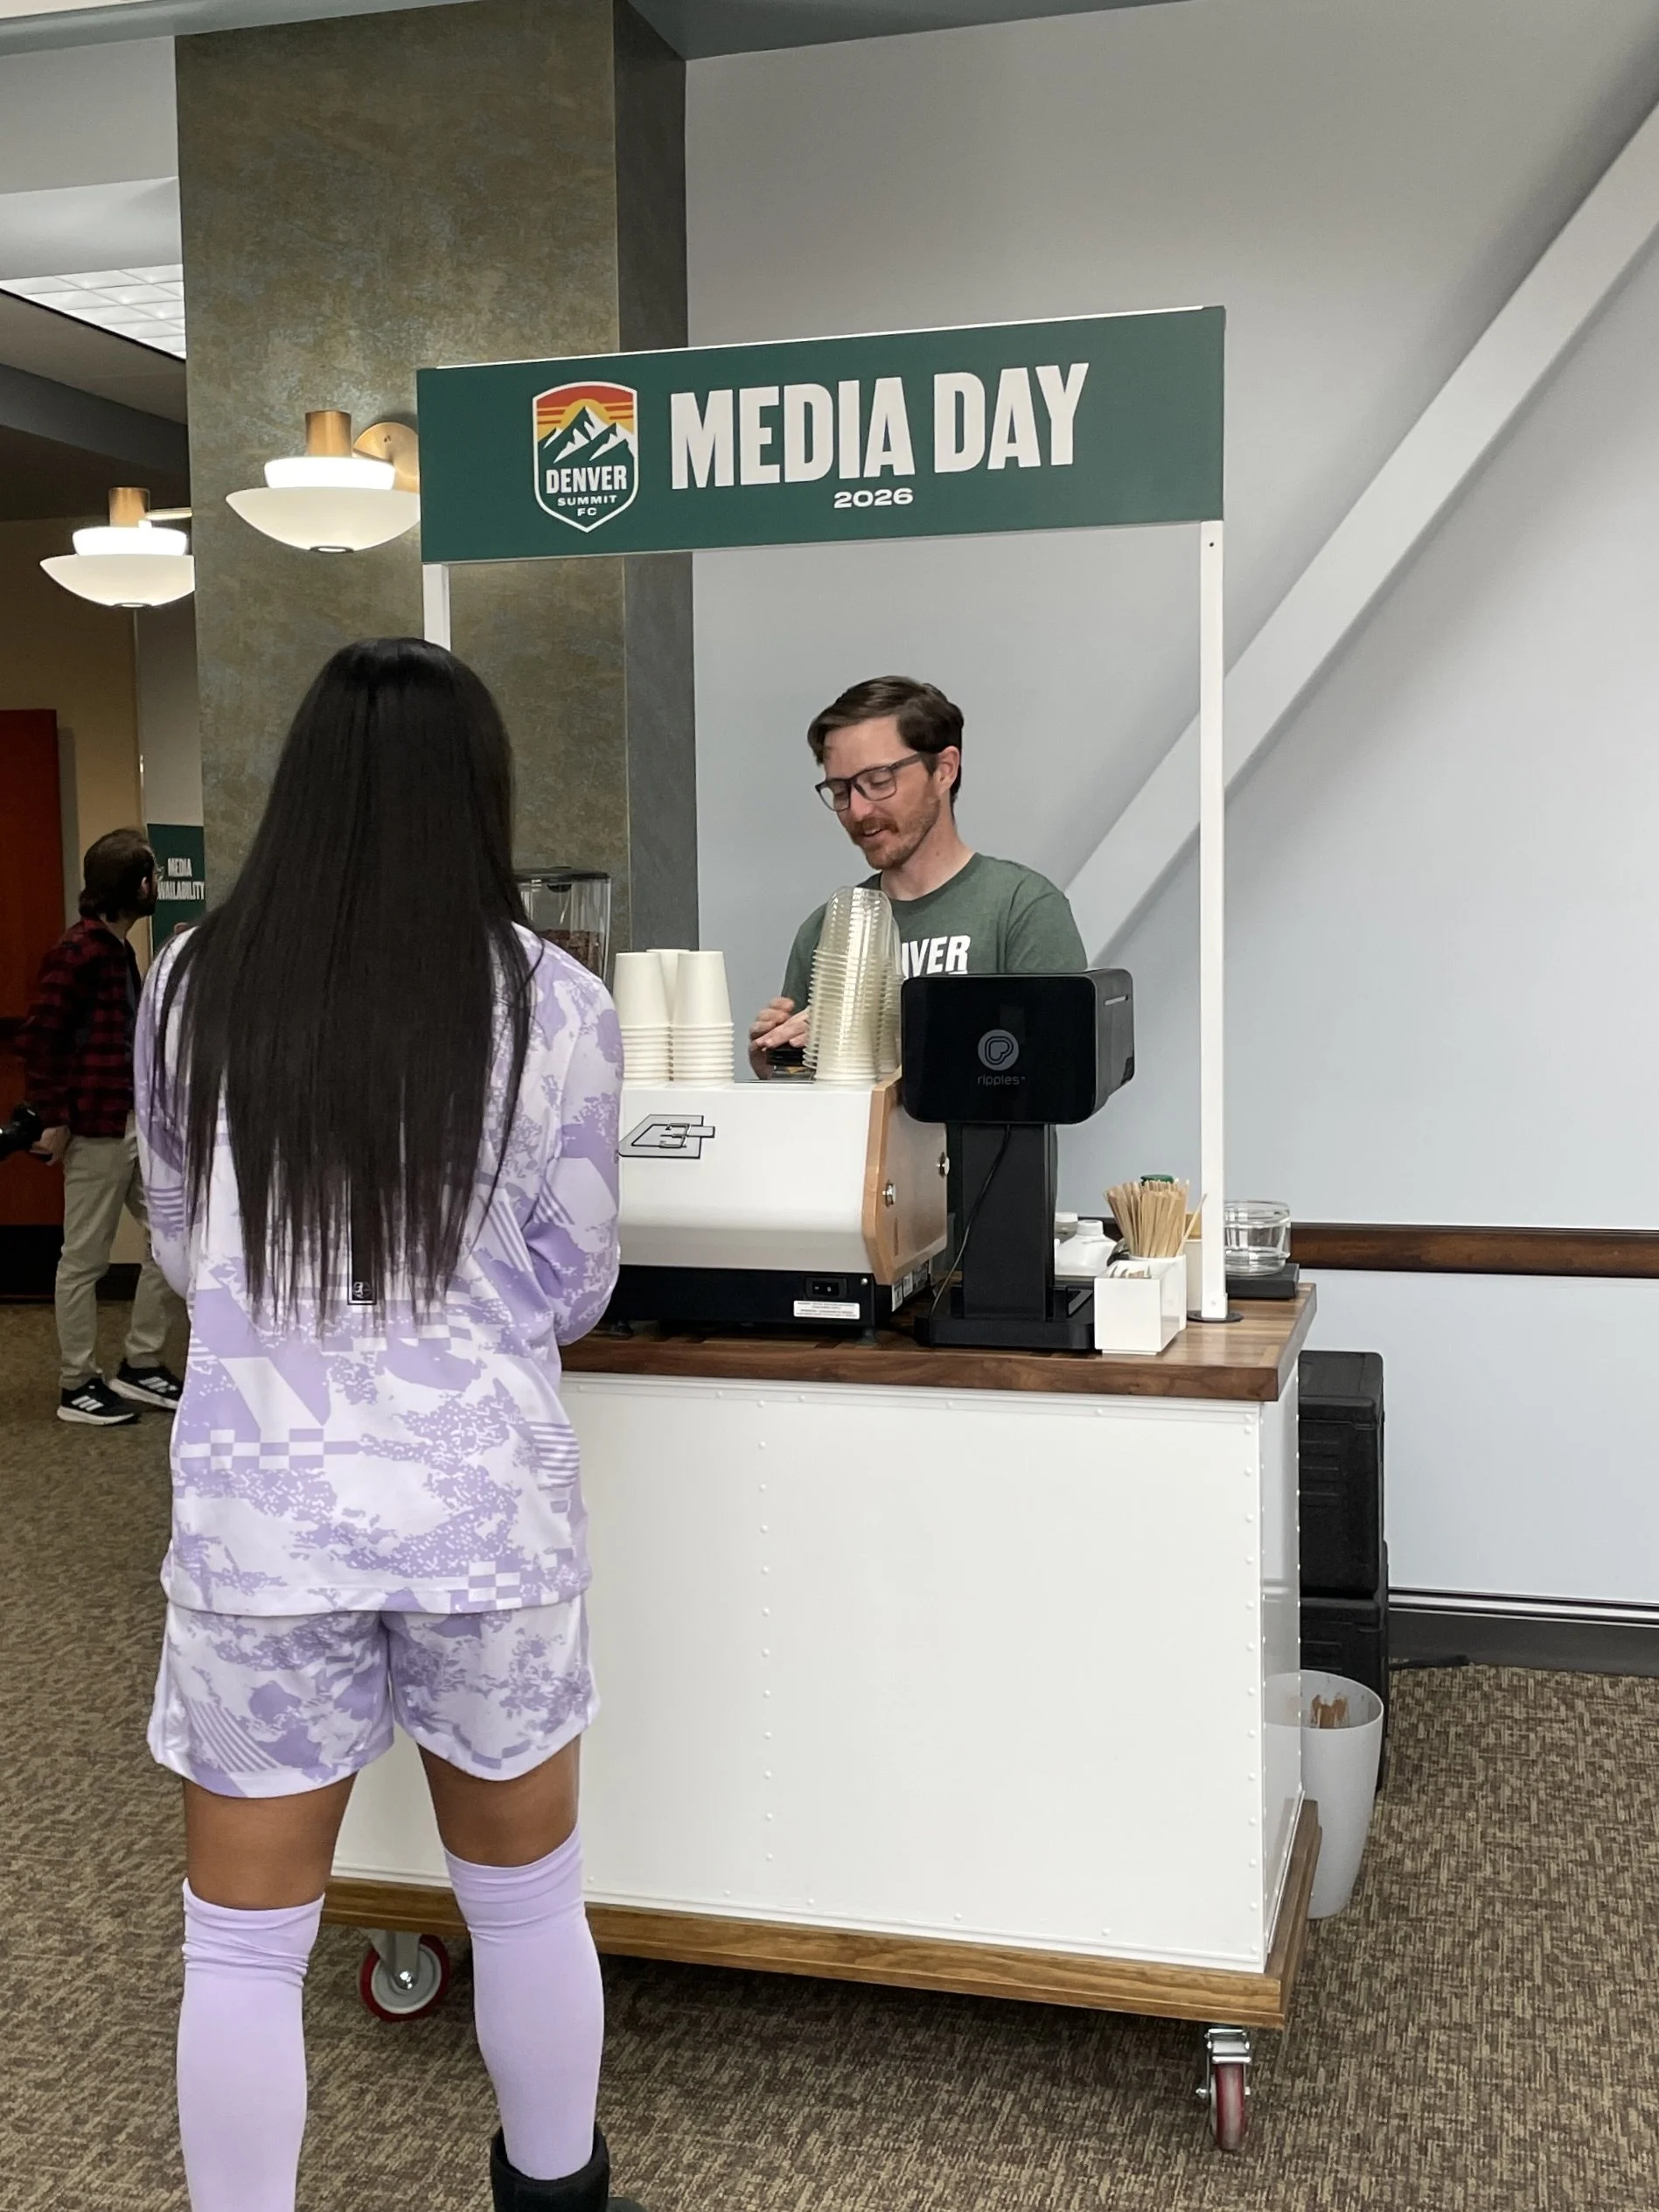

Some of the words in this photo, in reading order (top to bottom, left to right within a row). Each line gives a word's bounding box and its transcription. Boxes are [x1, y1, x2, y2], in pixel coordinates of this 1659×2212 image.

[671, 377, 915, 490] MEDIA
[933, 363, 1090, 474] DAY
[546, 465, 627, 494] DENVER
[557, 495, 617, 506] SUMMIT
[833, 488, 914, 508] 2026
[577, 507, 597, 517] FC
[167, 858, 192, 877] MEDIA
